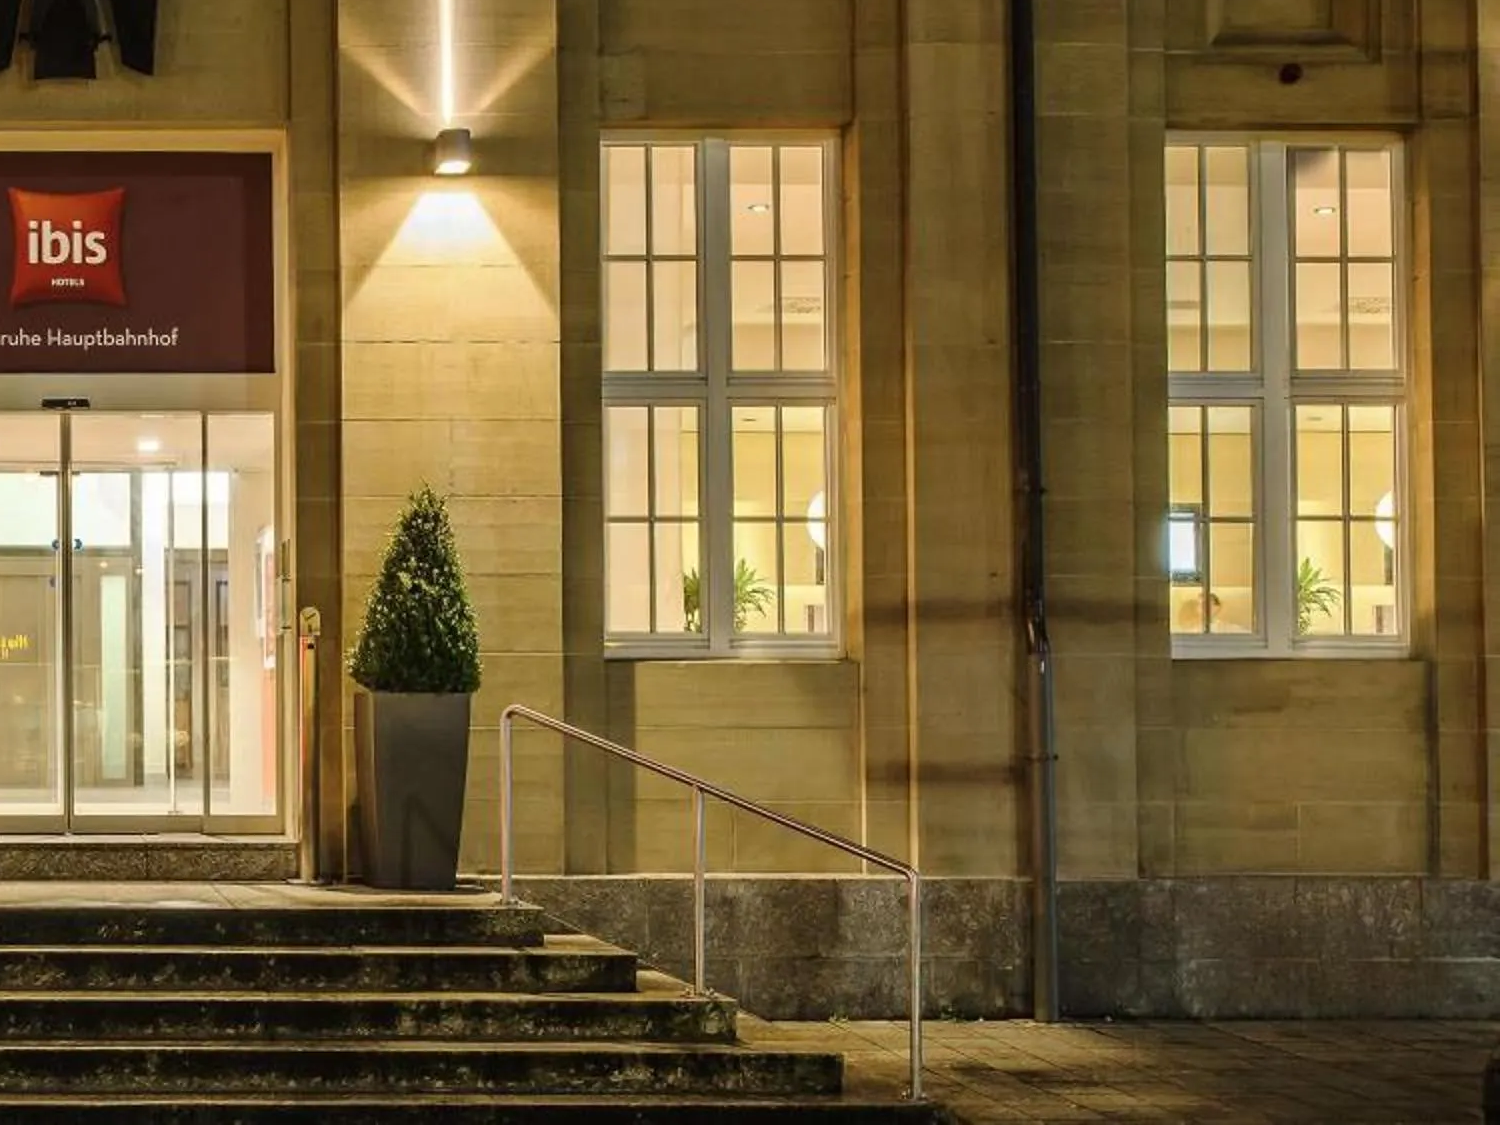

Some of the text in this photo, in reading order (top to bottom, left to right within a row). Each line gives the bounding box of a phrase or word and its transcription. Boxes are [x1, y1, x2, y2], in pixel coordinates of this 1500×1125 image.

[28, 219, 107, 265] ibis
[50, 277, 85, 287] HOTELS
[47, 327, 179, 350] Hauptbahnhof
